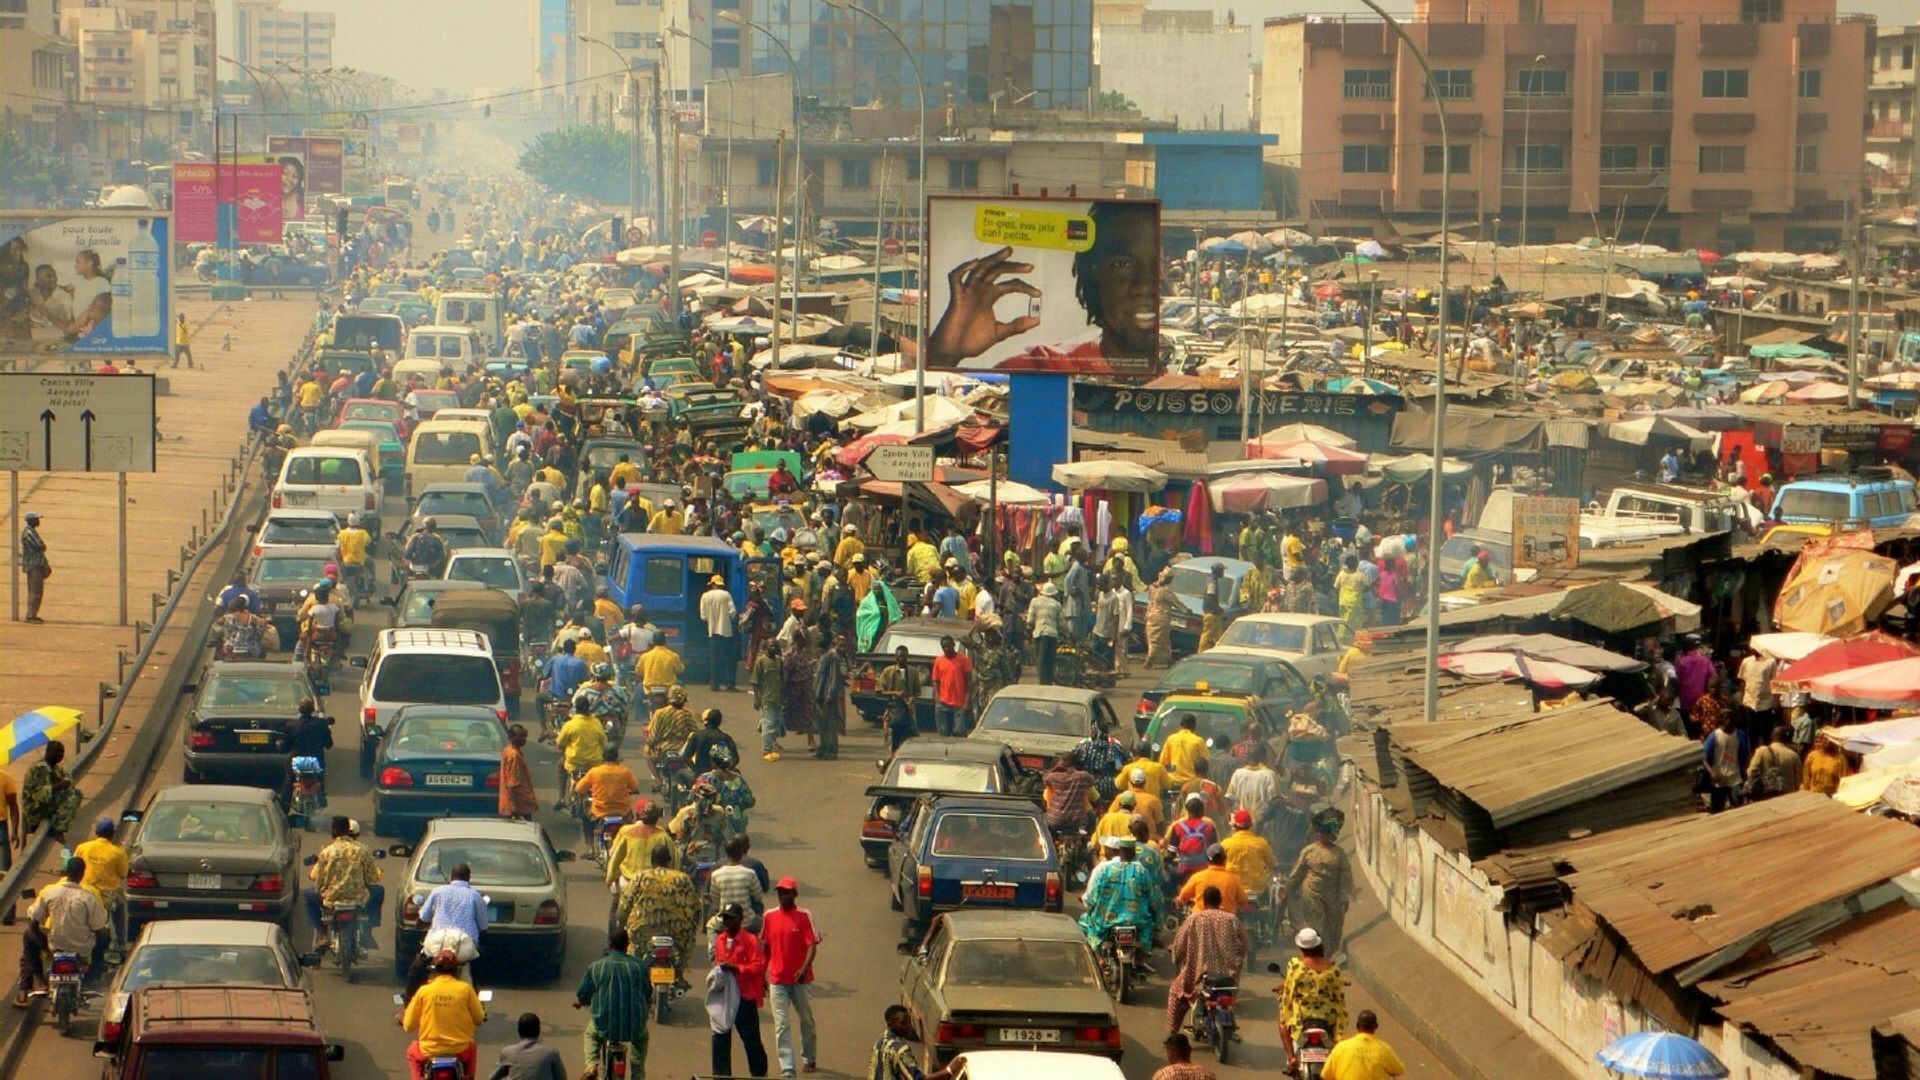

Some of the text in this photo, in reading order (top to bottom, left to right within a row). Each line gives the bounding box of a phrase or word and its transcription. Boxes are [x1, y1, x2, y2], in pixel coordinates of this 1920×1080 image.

[62, 224, 114, 236] pour toute
[983, 218, 994, 227] En
[1037, 223, 1056, 235] prix
[983, 228, 1001, 238] sont
[75, 235, 122, 248] la famille
[40, 378, 95, 387] Centre Ville
[882, 449, 930, 458] Centre Ville
